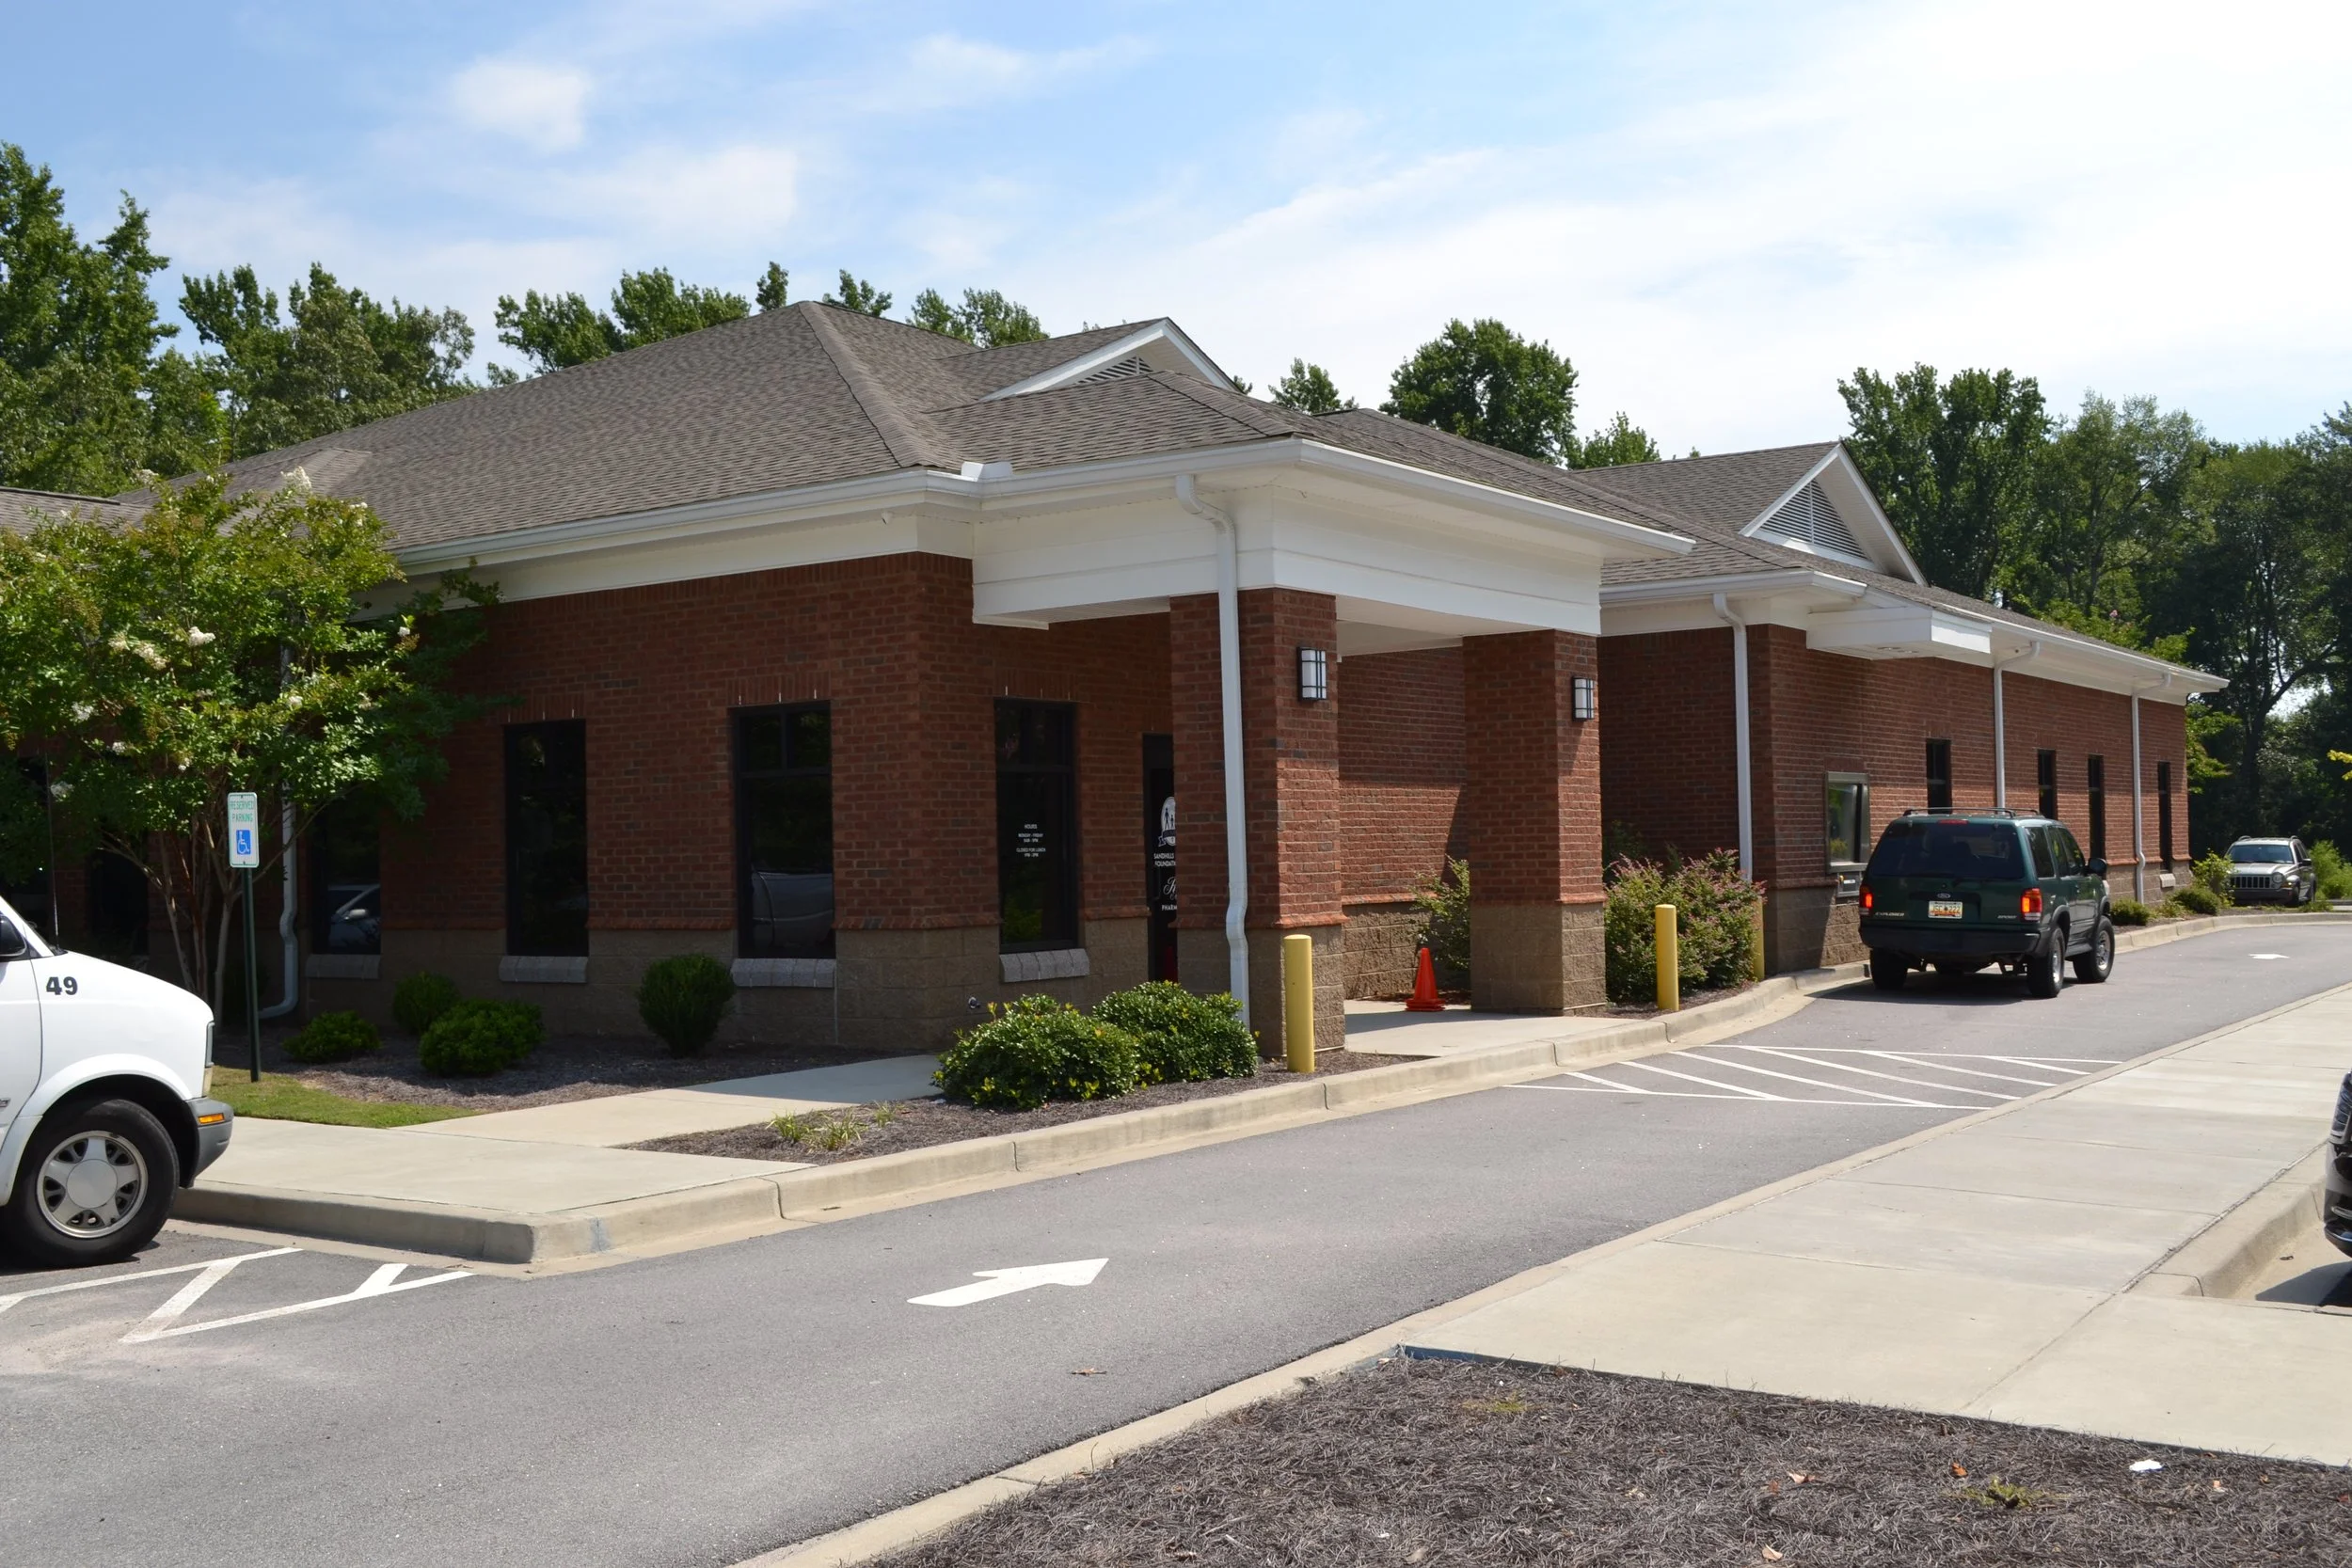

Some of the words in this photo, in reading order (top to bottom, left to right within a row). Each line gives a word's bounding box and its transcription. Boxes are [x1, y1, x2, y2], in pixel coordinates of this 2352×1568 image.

[230, 800, 253, 810] RESERVED
[232, 813, 253, 822] PARKING
[46, 976, 78, 995] 49
